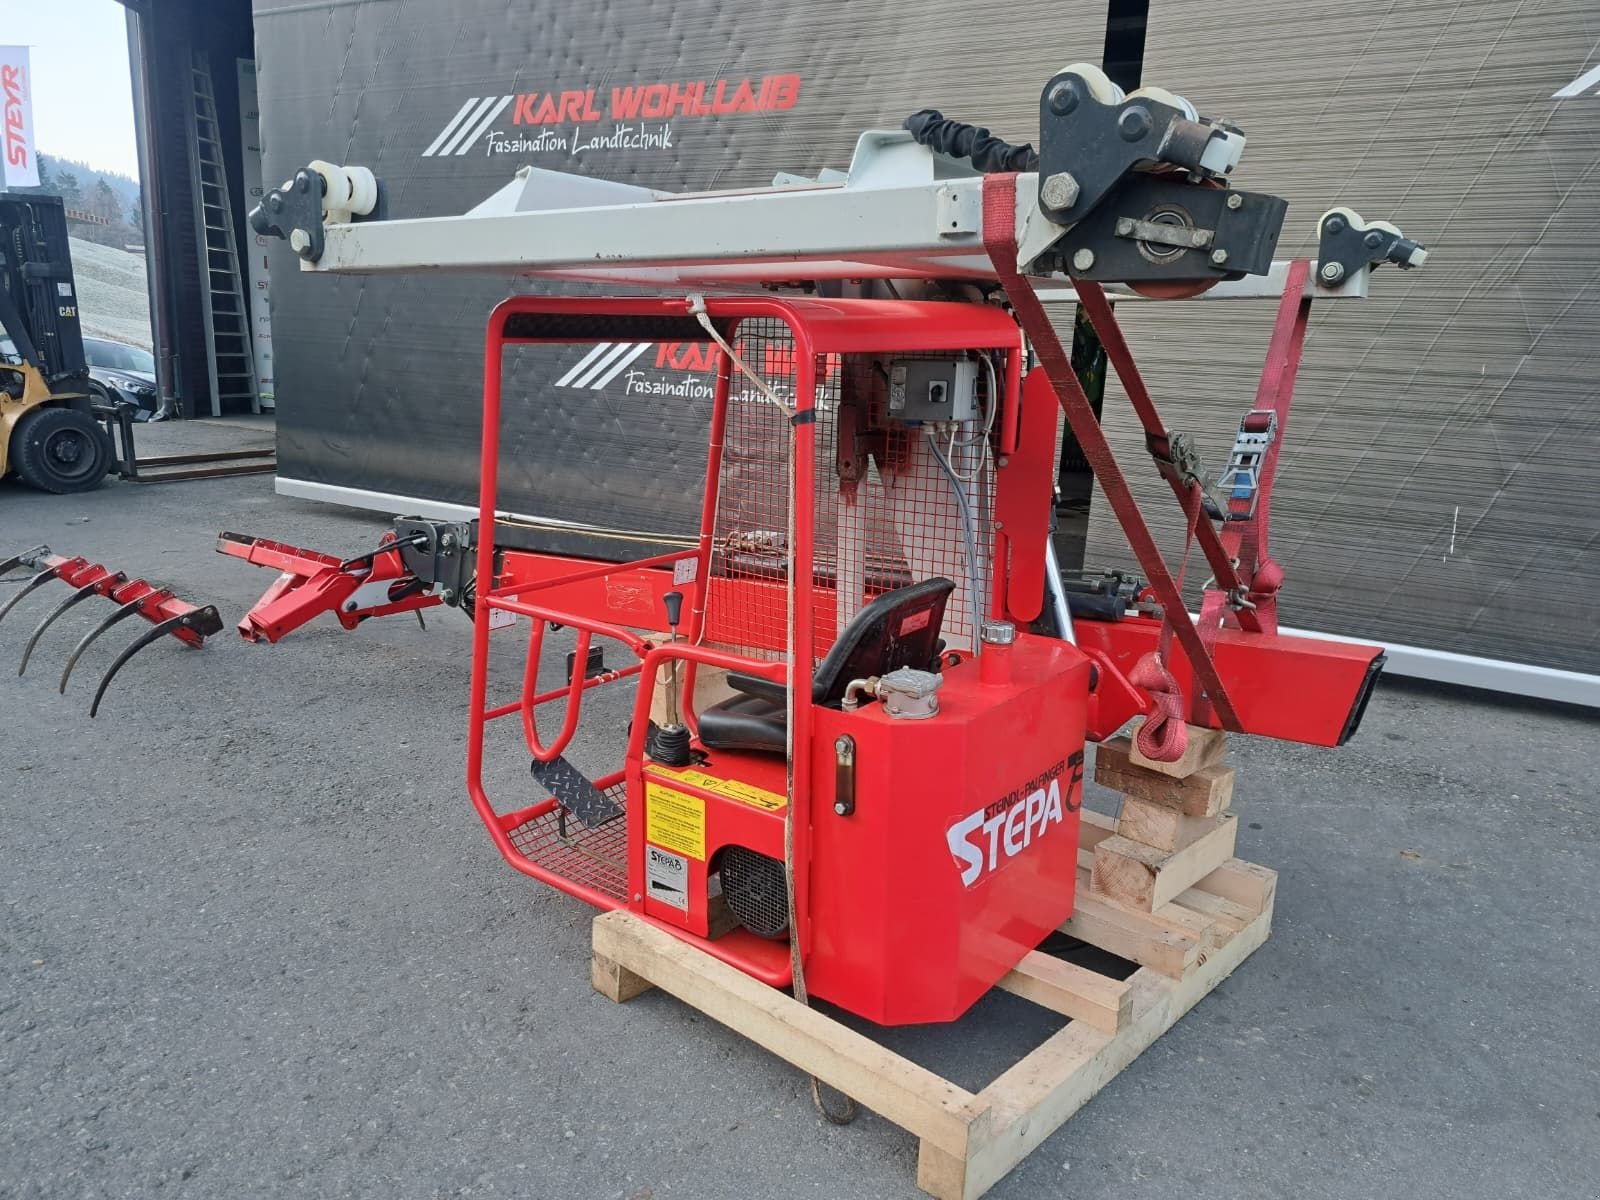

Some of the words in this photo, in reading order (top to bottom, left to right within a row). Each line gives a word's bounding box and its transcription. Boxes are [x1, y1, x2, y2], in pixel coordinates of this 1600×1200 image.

[2, 64, 26, 169] STEYR
[513, 90, 601, 125] KARL
[611, 73, 802, 120] WOHLLAIB
[486, 130, 567, 156] Faszination
[571, 122, 673, 156] Landtechnik
[59, 306, 77, 318] CAT
[624, 371, 714, 399] Faszination
[946, 778, 1063, 888] STEPA
